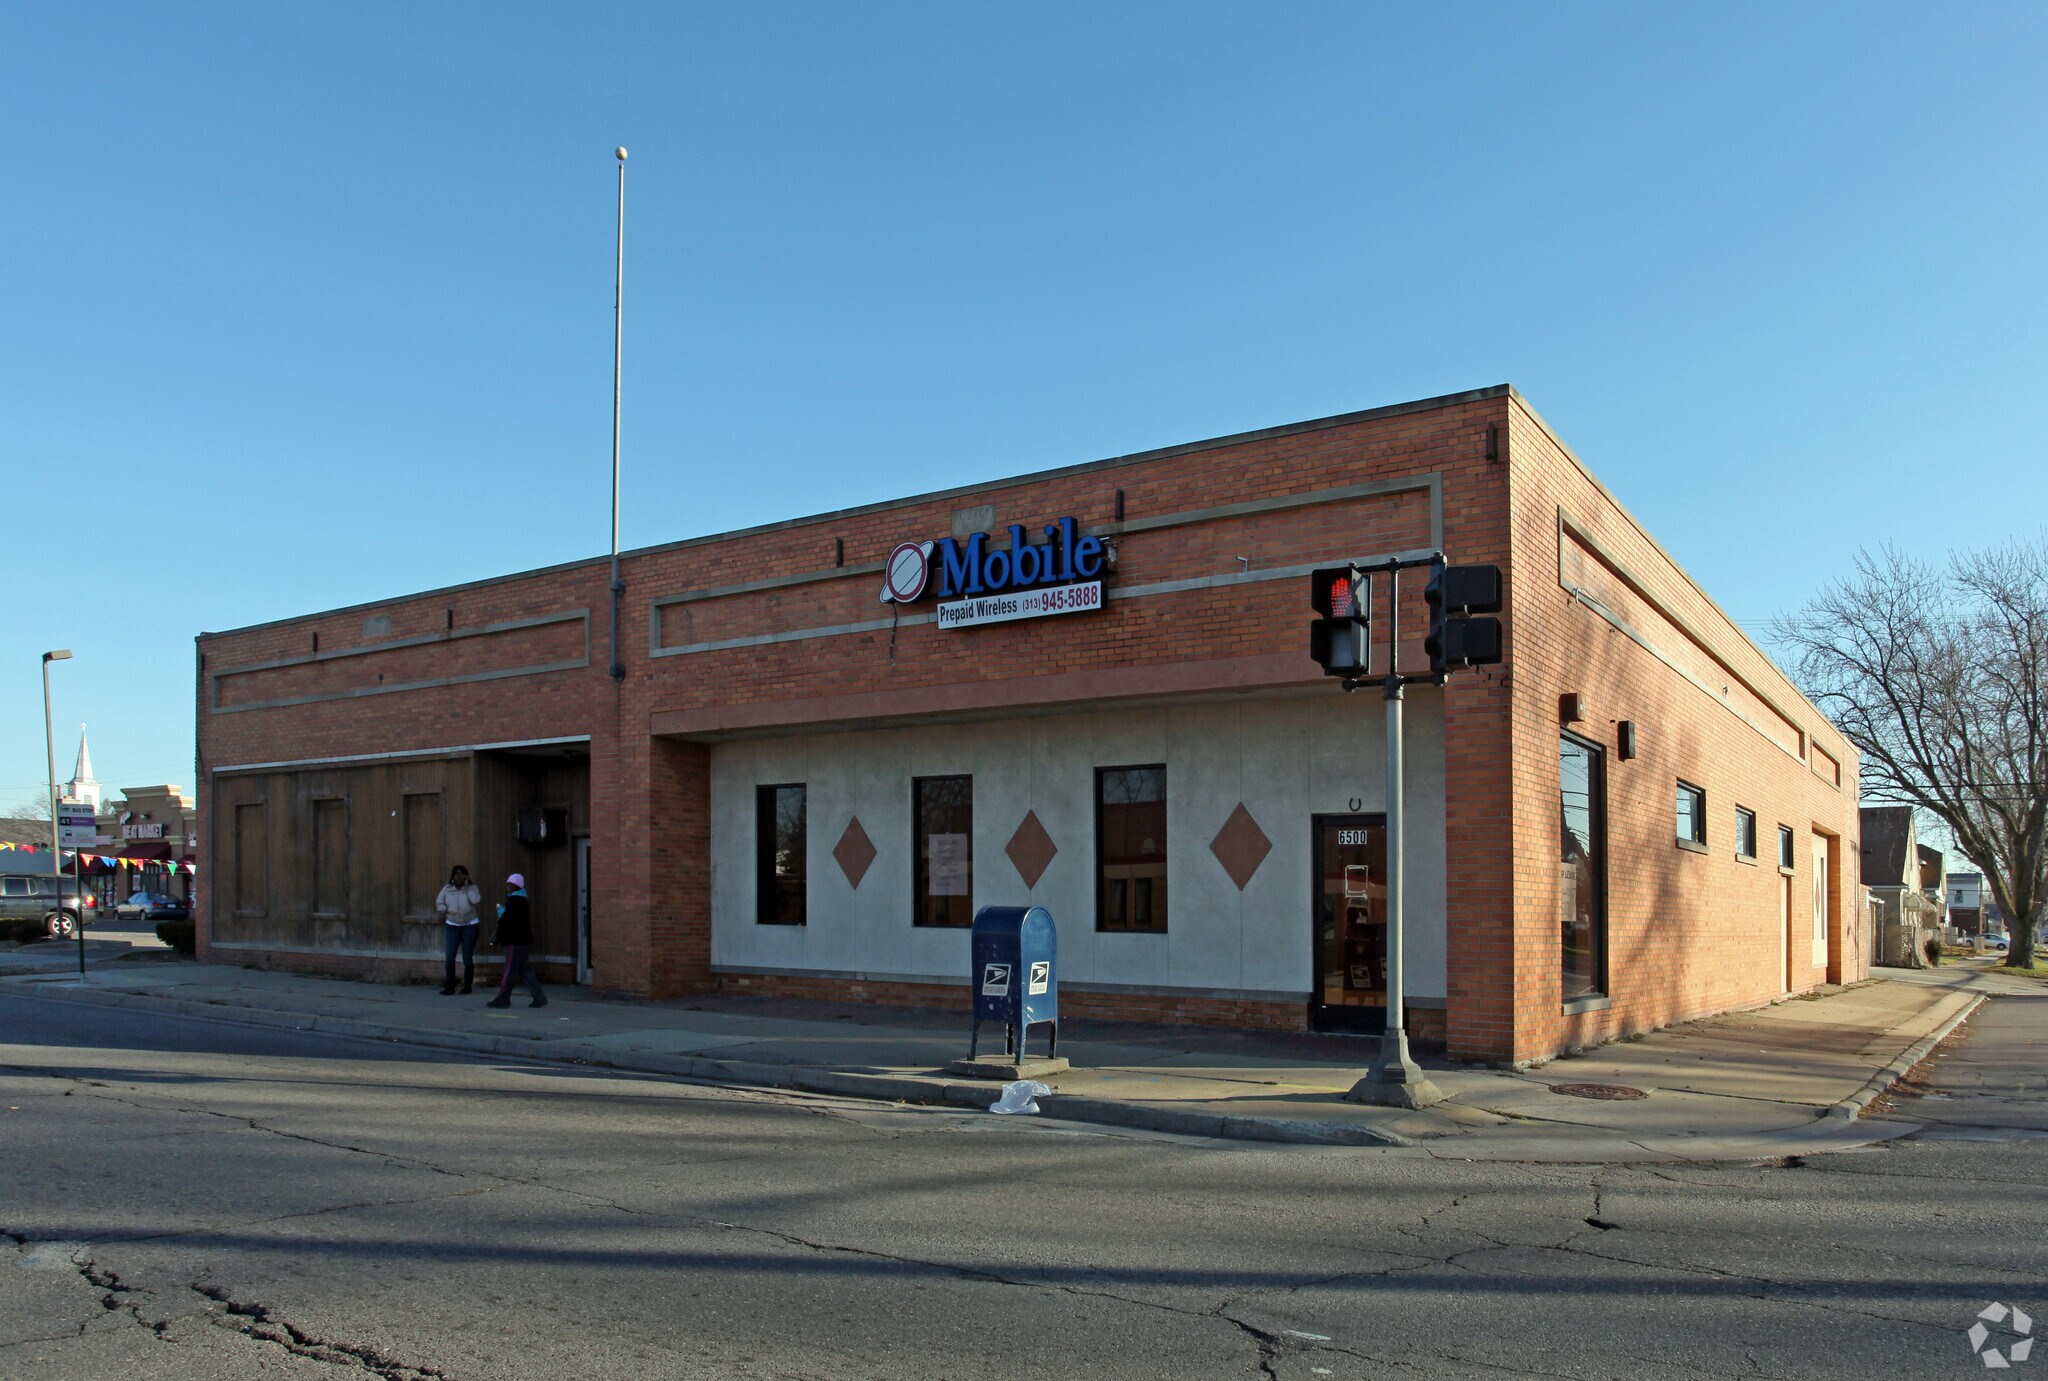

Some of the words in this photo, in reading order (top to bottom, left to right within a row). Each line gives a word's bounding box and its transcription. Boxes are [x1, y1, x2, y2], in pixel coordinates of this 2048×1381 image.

[937, 516, 1102, 597] Mobile
[940, 602, 974, 624] Prepaid
[976, 599, 1018, 617] Wireless
[1022, 597, 1041, 612] (313)
[1042, 585, 1098, 611] 945-5888
[1340, 831, 1366, 844] 6500
